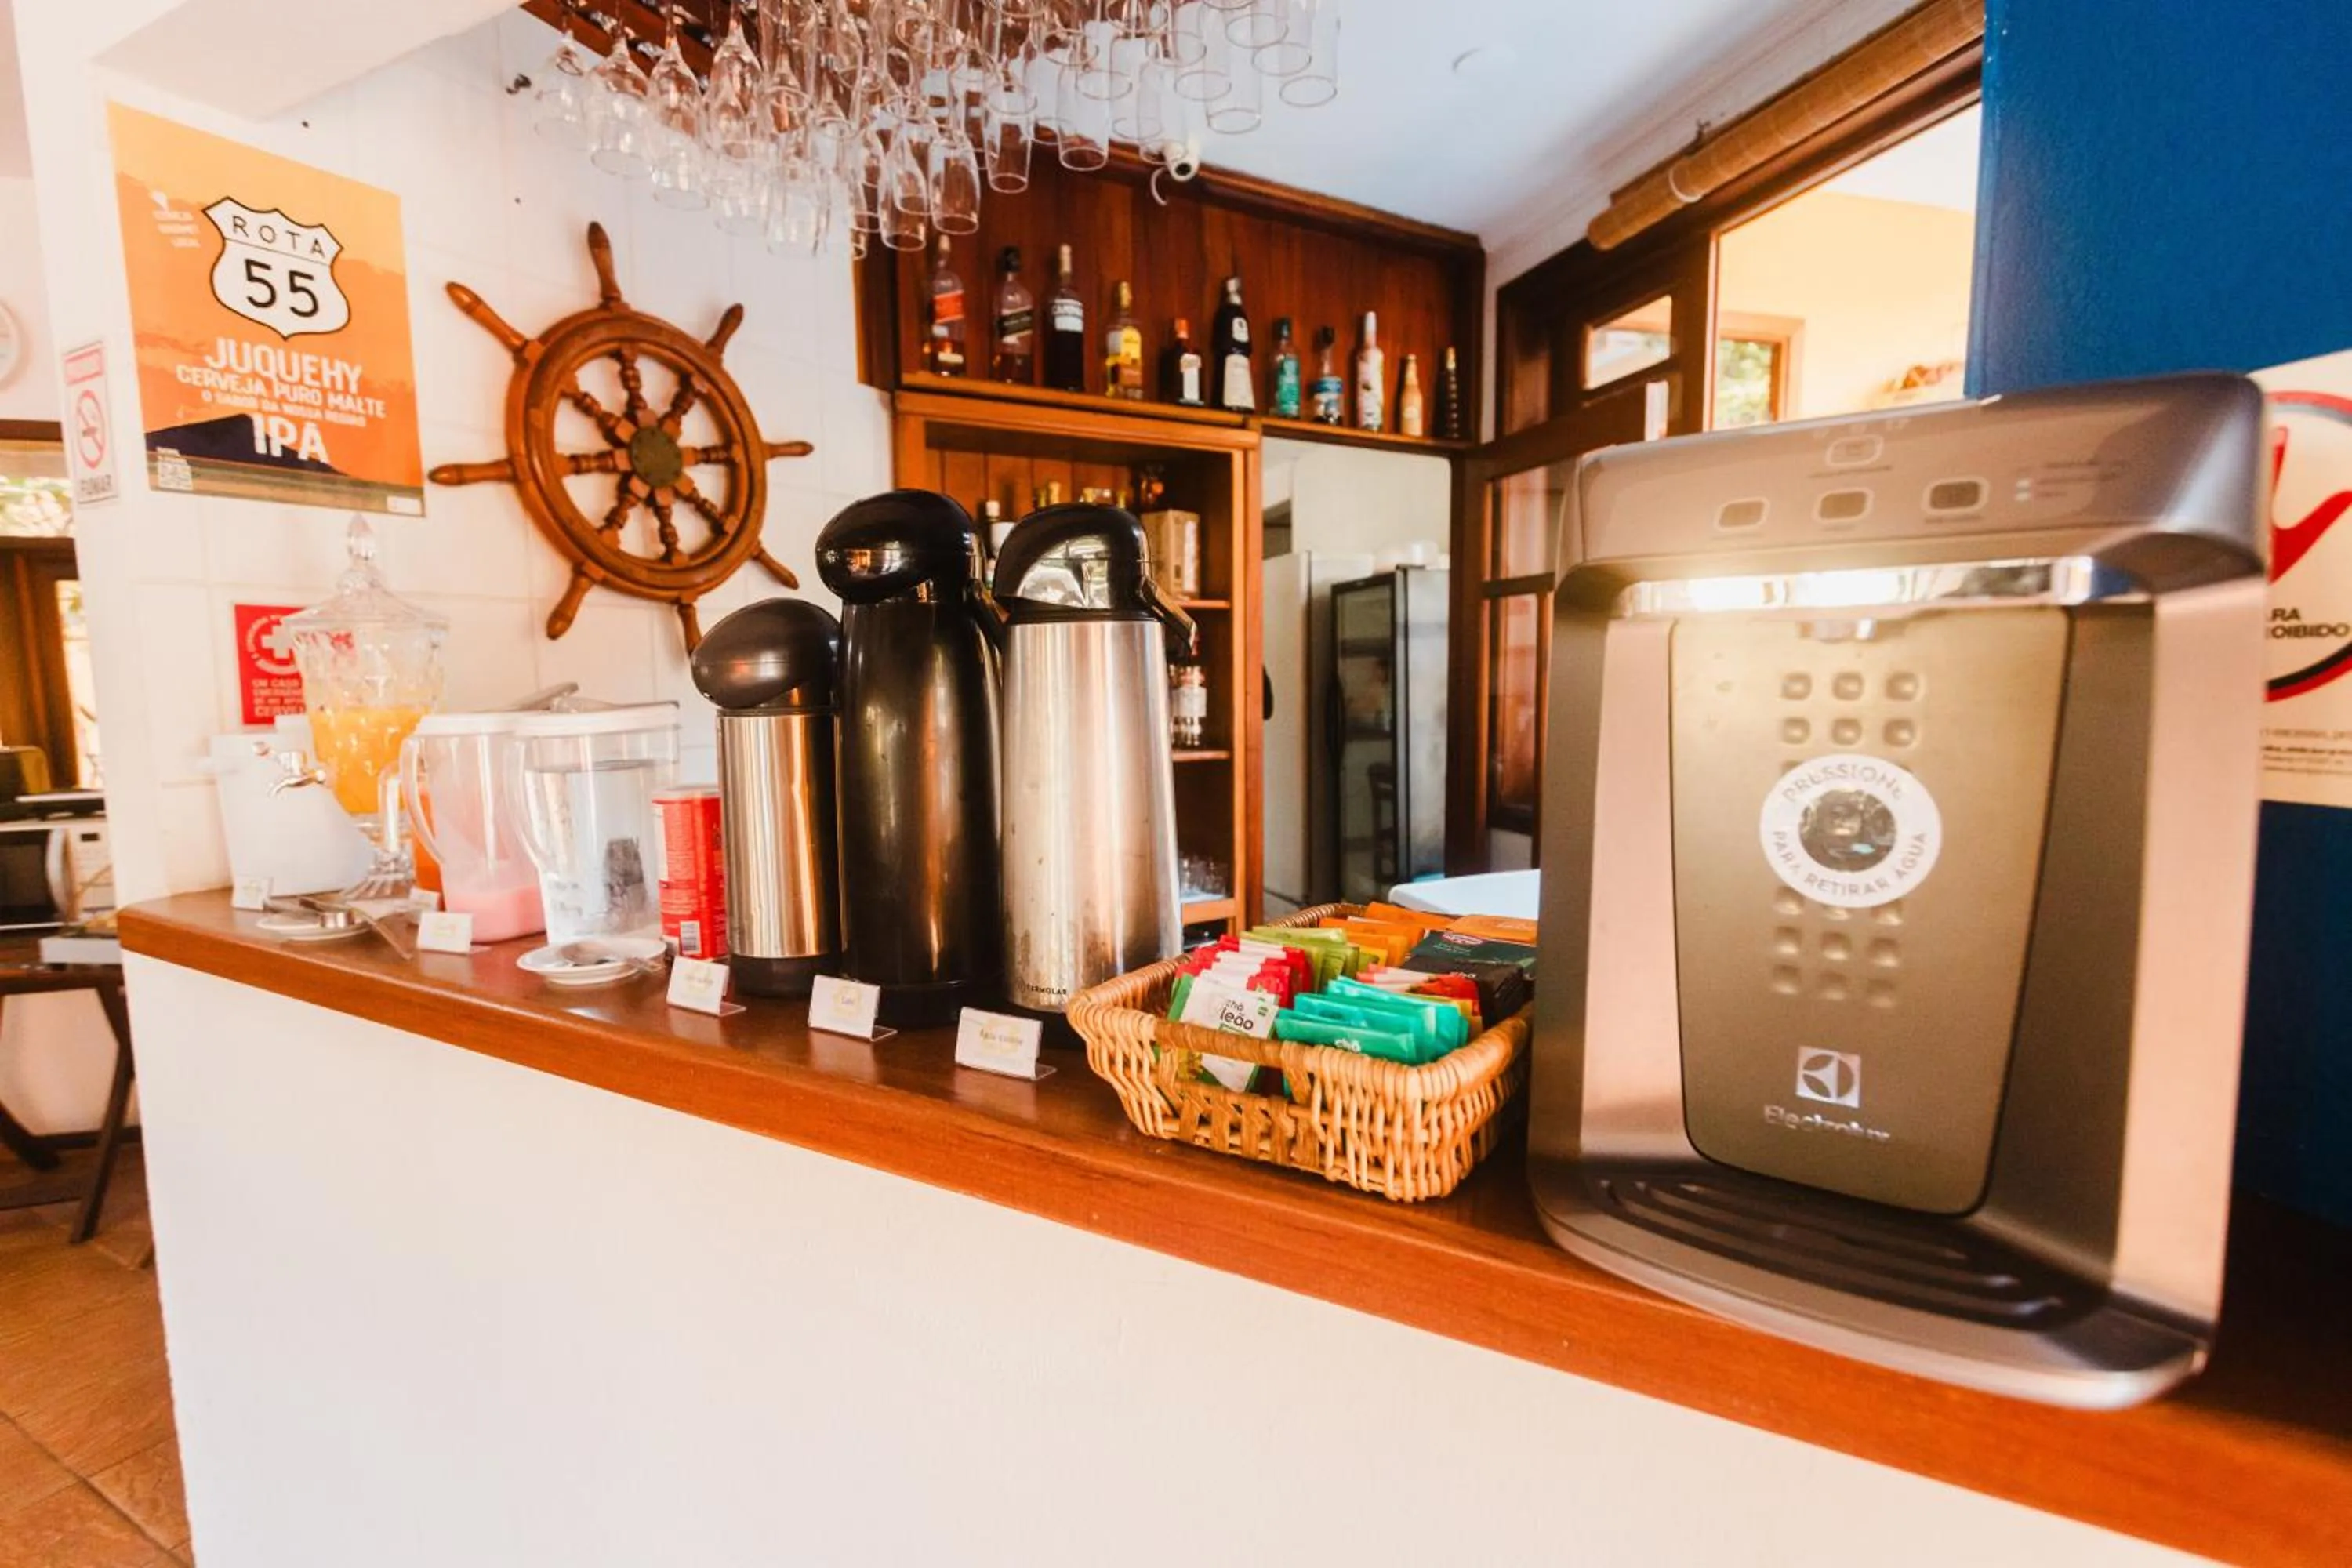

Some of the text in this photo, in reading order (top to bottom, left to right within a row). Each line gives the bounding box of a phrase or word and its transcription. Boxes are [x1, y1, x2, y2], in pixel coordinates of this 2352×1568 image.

[232, 215, 326, 259] ROTA
[244, 258, 320, 318] 55
[203, 336, 363, 394] JUQUEHY
[175, 364, 387, 419] CERVEJA PURO MALTE
[251, 412, 332, 464] IPA
[2265, 607, 2301, 622] RA
[2265, 622, 2350, 639] OIBIDO
[1803, 872, 1891, 896] RETIRAR
[1220, 1006, 1254, 1031] leão
